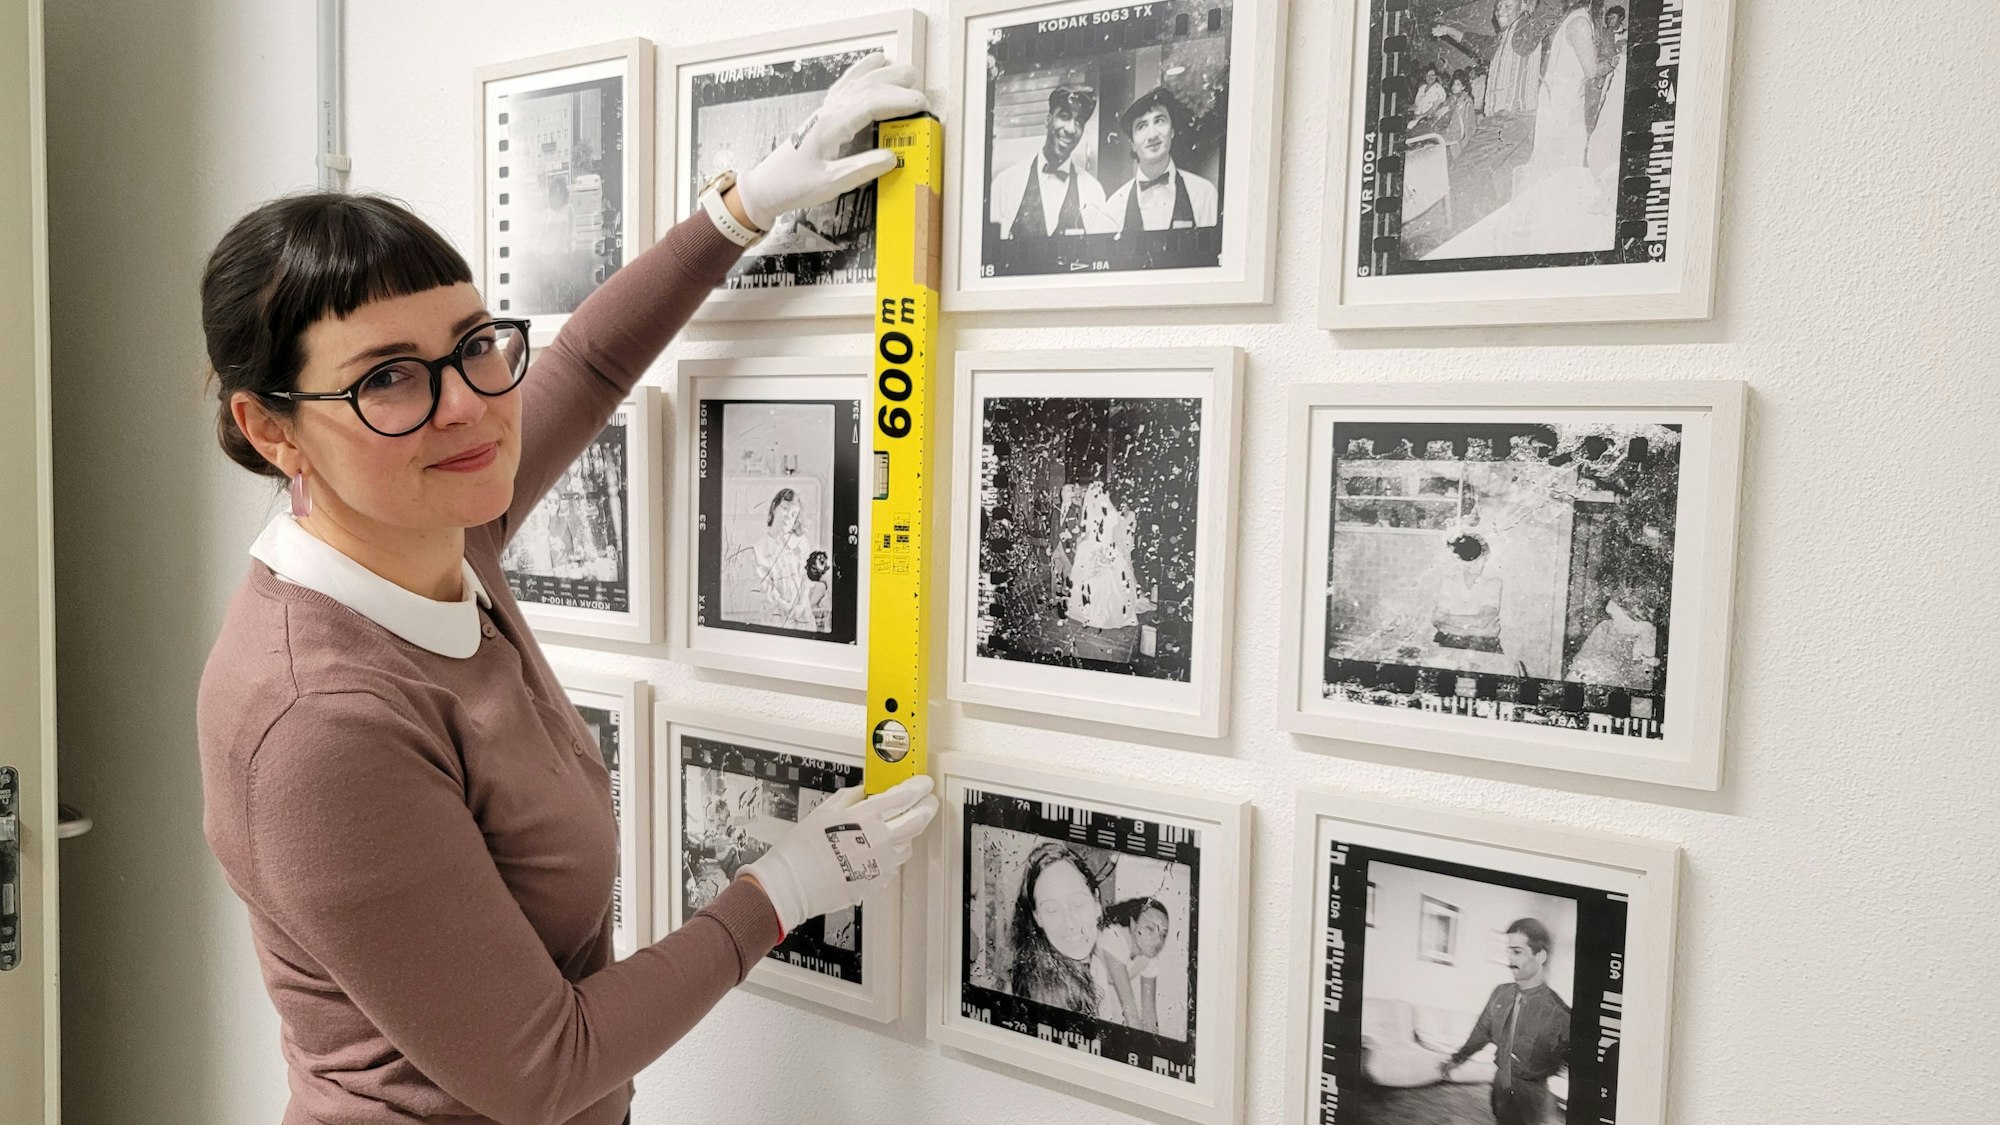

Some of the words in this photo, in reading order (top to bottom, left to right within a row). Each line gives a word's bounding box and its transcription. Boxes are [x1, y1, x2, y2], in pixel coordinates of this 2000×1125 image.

[1038, 15, 1089, 34] KODAK
[1092, 8, 1130, 25] 5063
[1133, 4, 1153, 18] TX
[1657, 68, 1670, 98] 26A
[1363, 131, 1376, 183] 100-4
[1361, 188, 1374, 215] VR
[980, 264, 995, 277] 18
[1092, 260, 1110, 270] 18A
[878, 331, 913, 438] 600
[852, 400, 860, 420] 33A
[700, 430, 708, 478] KODAK
[699, 514, 707, 530] 33
[848, 524, 858, 545] 33
[541, 595, 564, 605] 100-4
[566, 598, 578, 607] VR
[580, 599, 611, 610] KODAK
[698, 594, 706, 613] TX
[801, 756, 825, 769] XRG
[1016, 799, 1031, 811] 7A
[1133, 820, 1145, 834] 8
[855, 835, 865, 845] 8
[1330, 894, 1341, 919] 10A
[1609, 952, 1622, 980] 10A
[1013, 1020, 1028, 1033] 7A
[1127, 1052, 1139, 1066] 8
